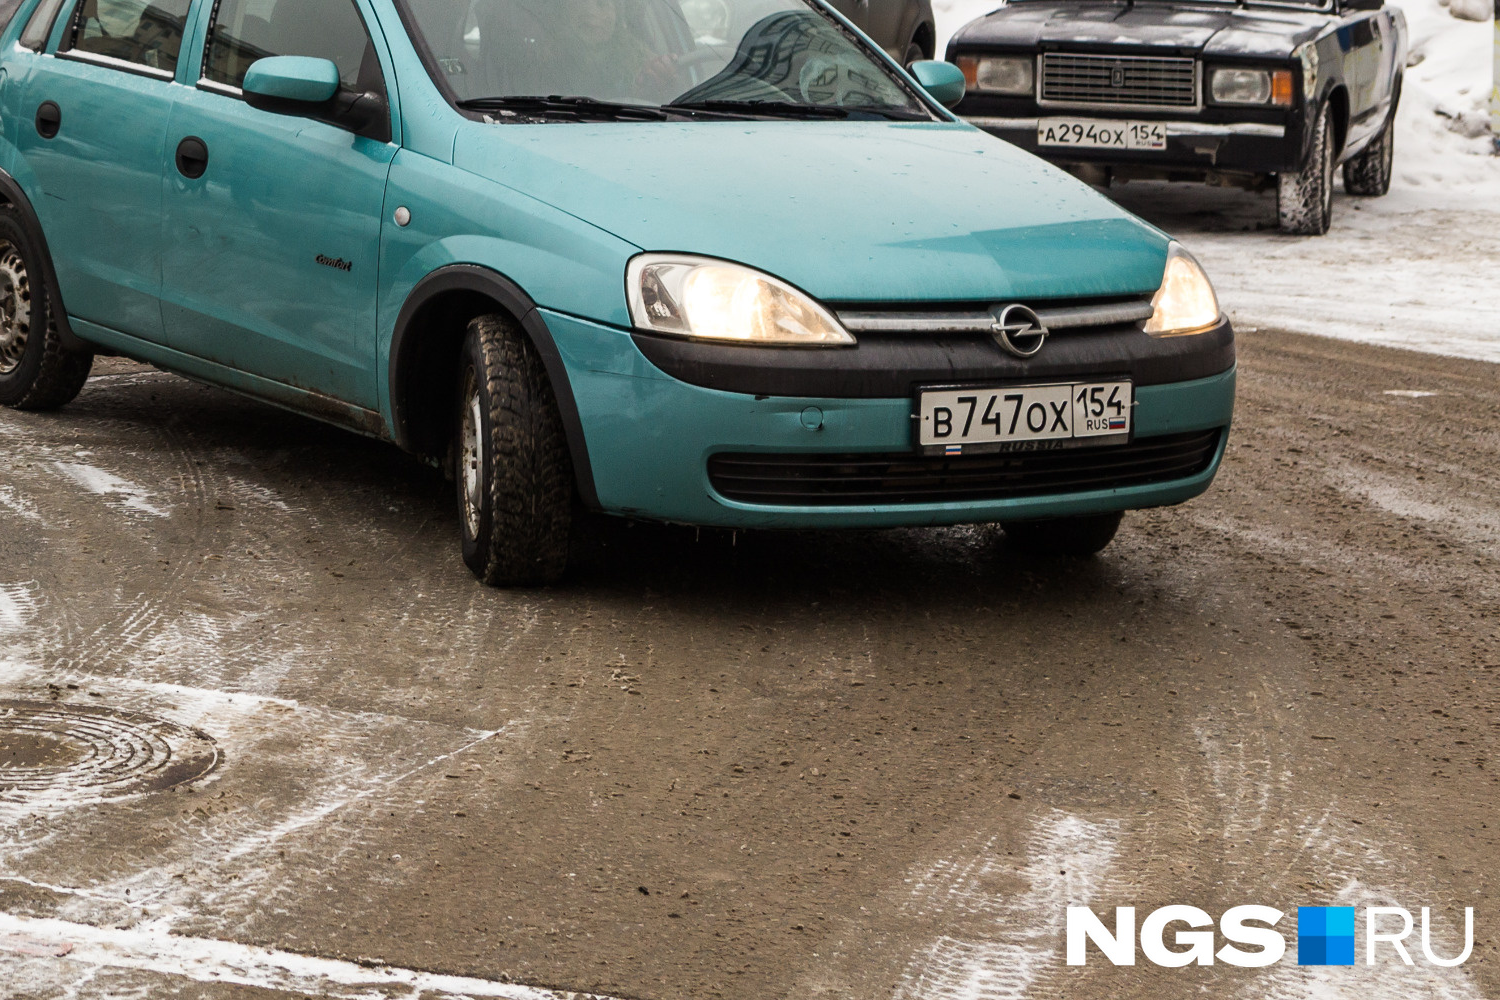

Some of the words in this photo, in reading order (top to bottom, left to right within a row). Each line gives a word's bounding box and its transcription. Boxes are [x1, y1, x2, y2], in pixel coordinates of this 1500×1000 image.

[1045, 123, 1124, 145] А294ОХ
[1130, 124, 1162, 141] 154
[933, 393, 1069, 438] В747ОХ
[1076, 386, 1122, 418] 154
[1086, 418, 1109, 431] RUS
